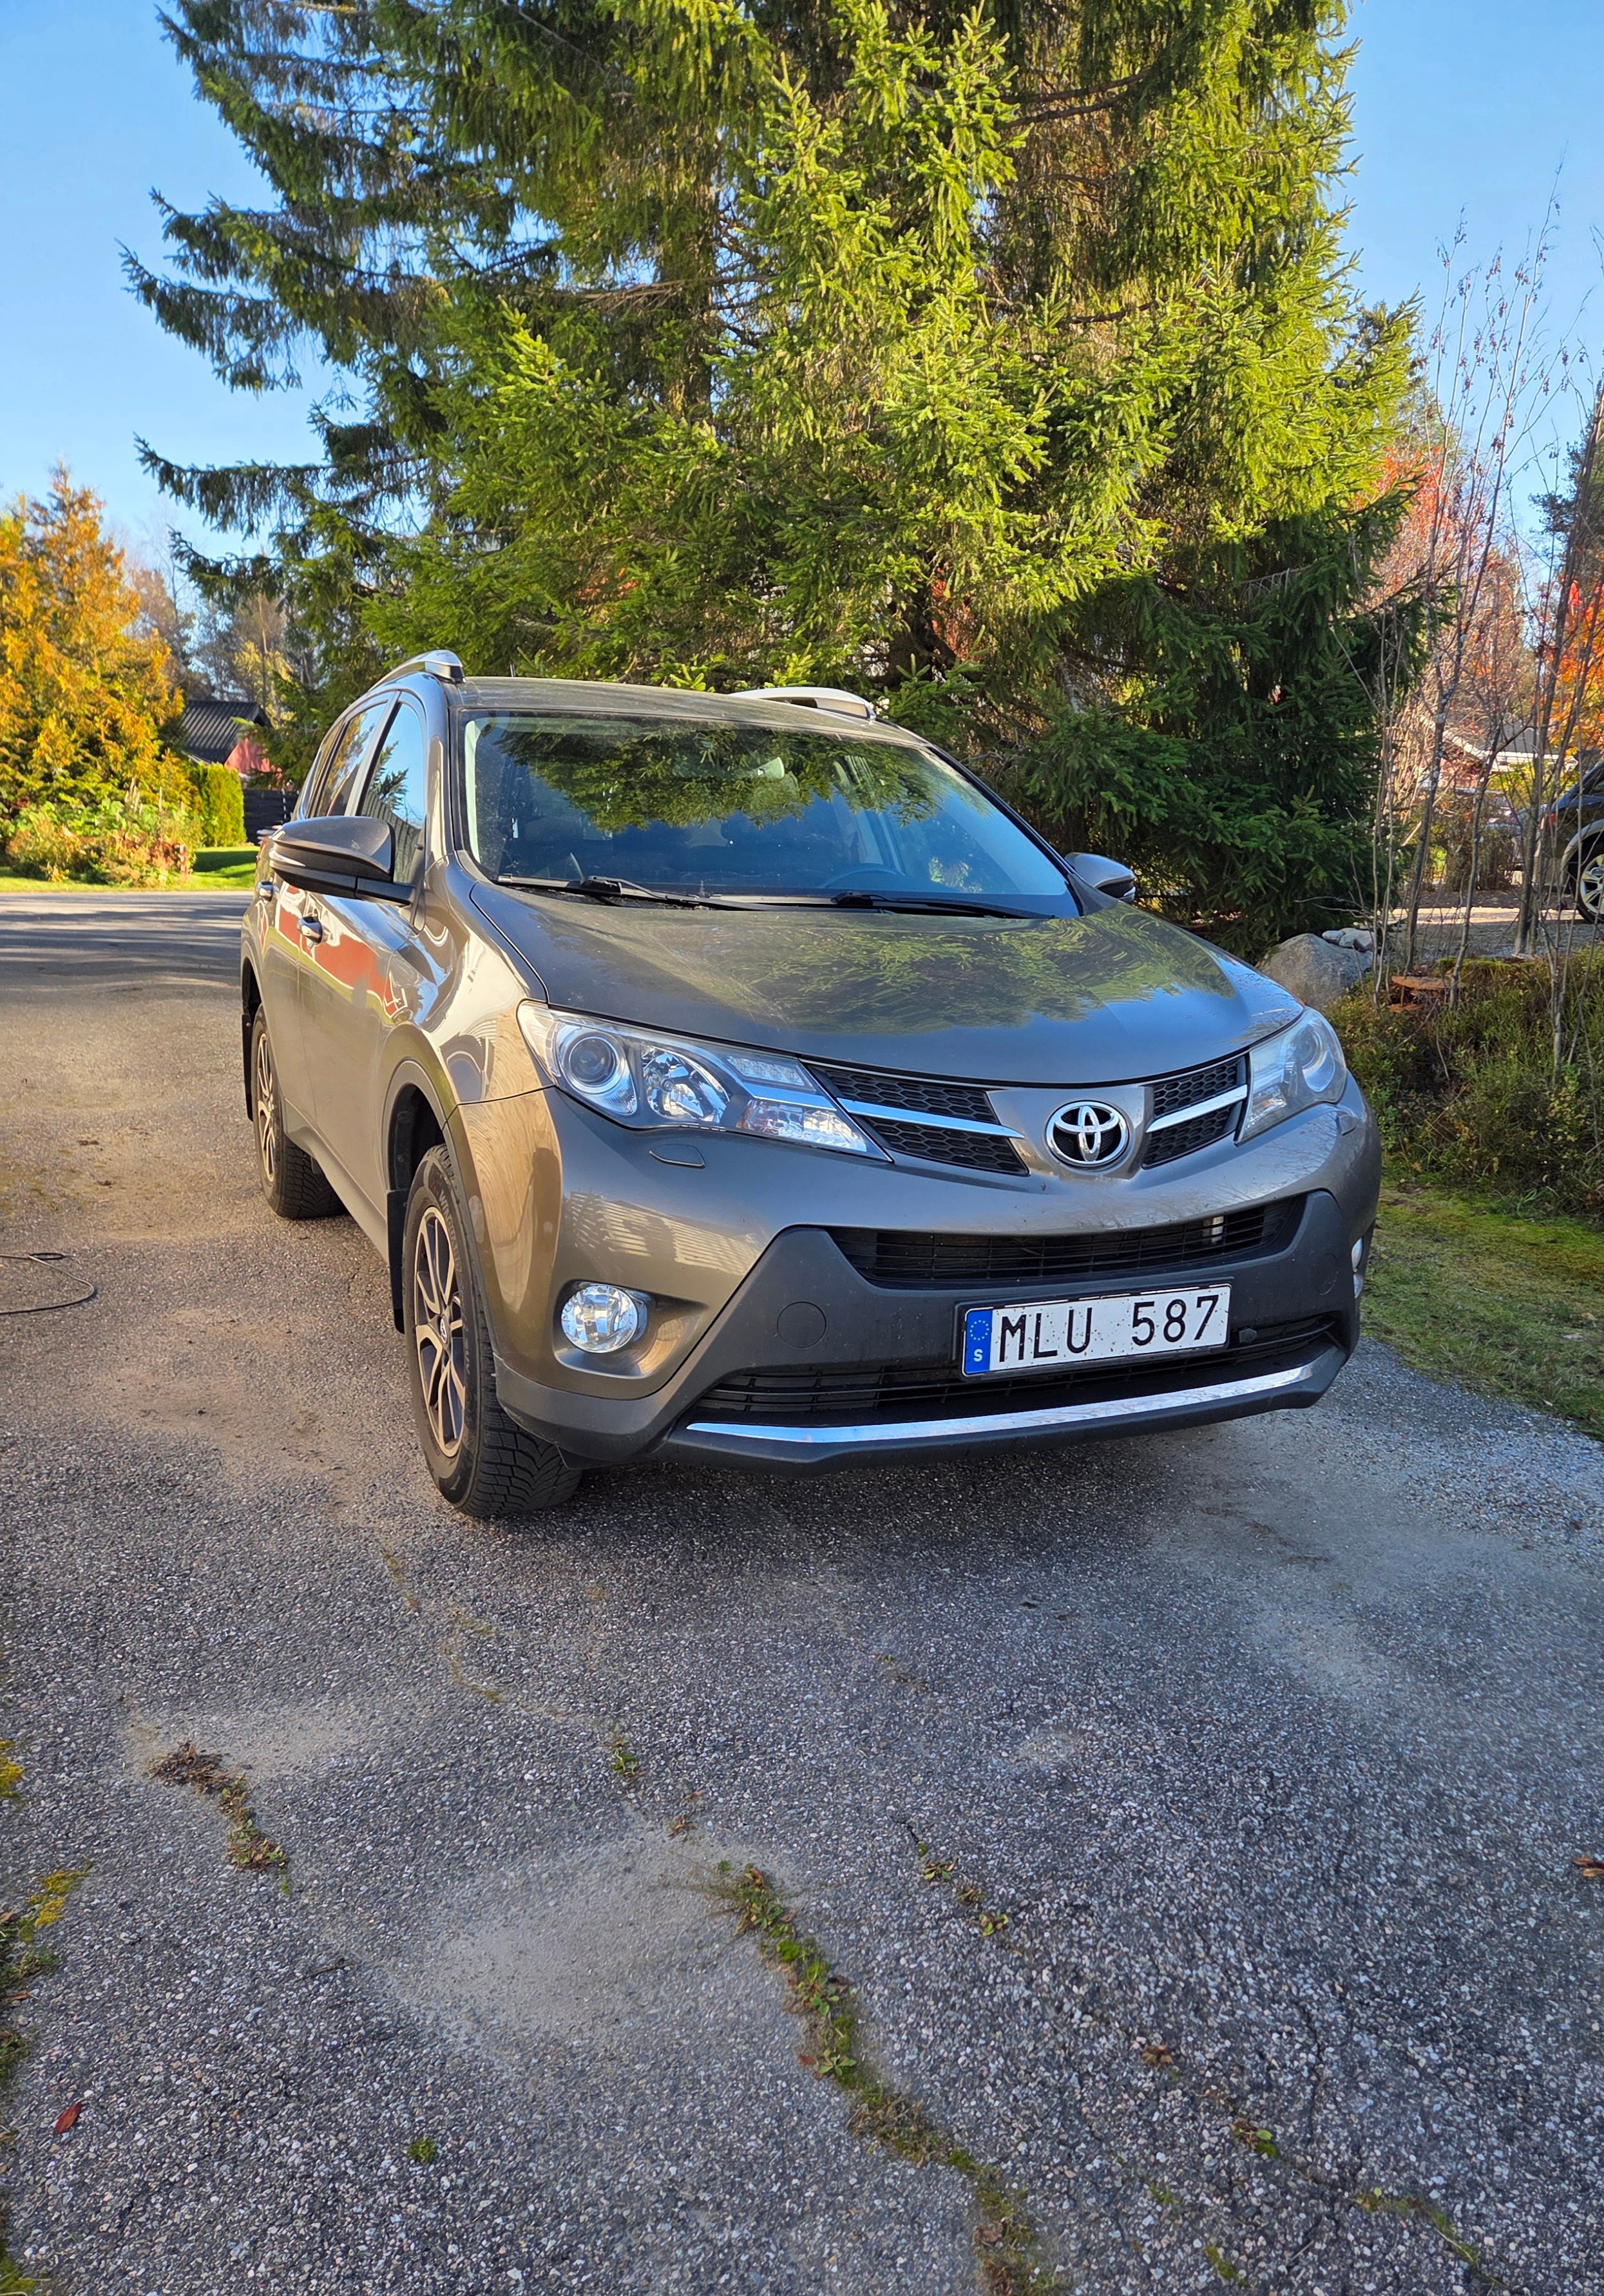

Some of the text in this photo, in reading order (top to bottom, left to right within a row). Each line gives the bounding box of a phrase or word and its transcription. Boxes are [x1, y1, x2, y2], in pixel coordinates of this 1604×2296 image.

[439, 1189, 463, 1272] WINGUARD
[973, 1348, 983, 1362] S
[998, 1295, 1219, 1363] MLU 587
